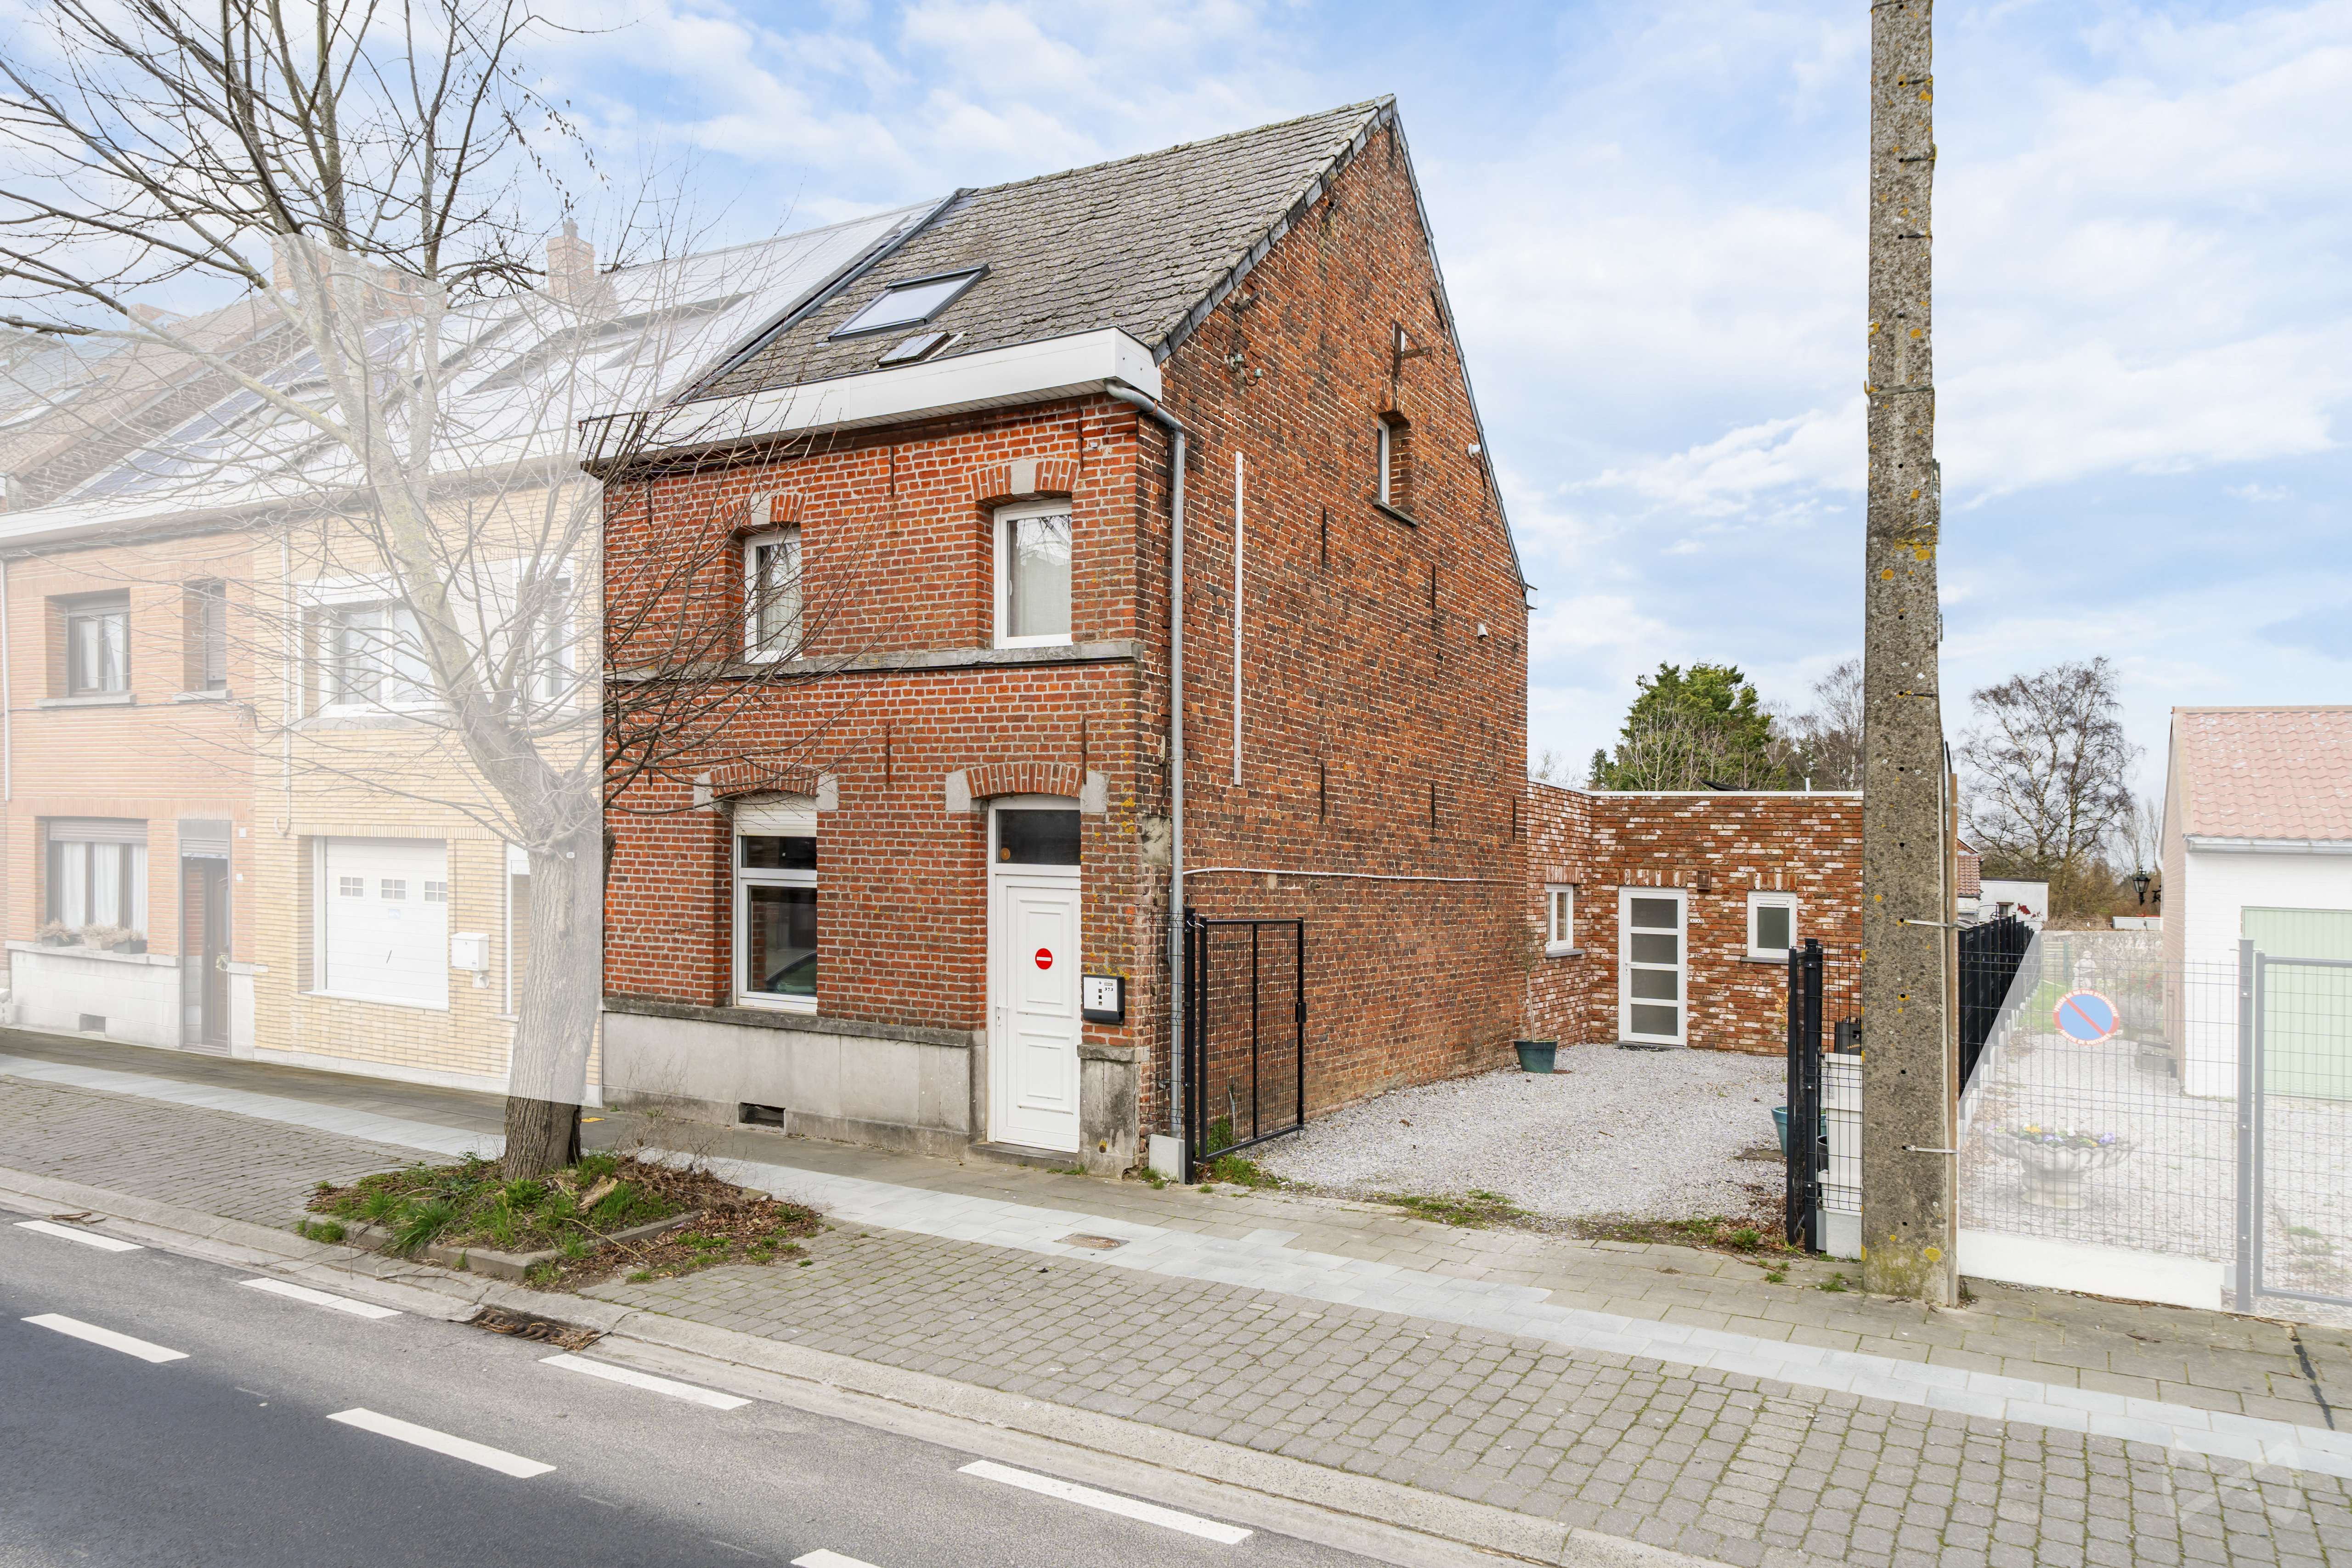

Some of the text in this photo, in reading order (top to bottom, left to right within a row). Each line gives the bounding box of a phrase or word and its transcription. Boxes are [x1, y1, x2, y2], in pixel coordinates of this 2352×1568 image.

[2094, 992, 2119, 1017] STATIONNER
[2060, 1029, 2078, 1043] SORTIE
[2086, 1033, 2112, 1045] VOITURES
